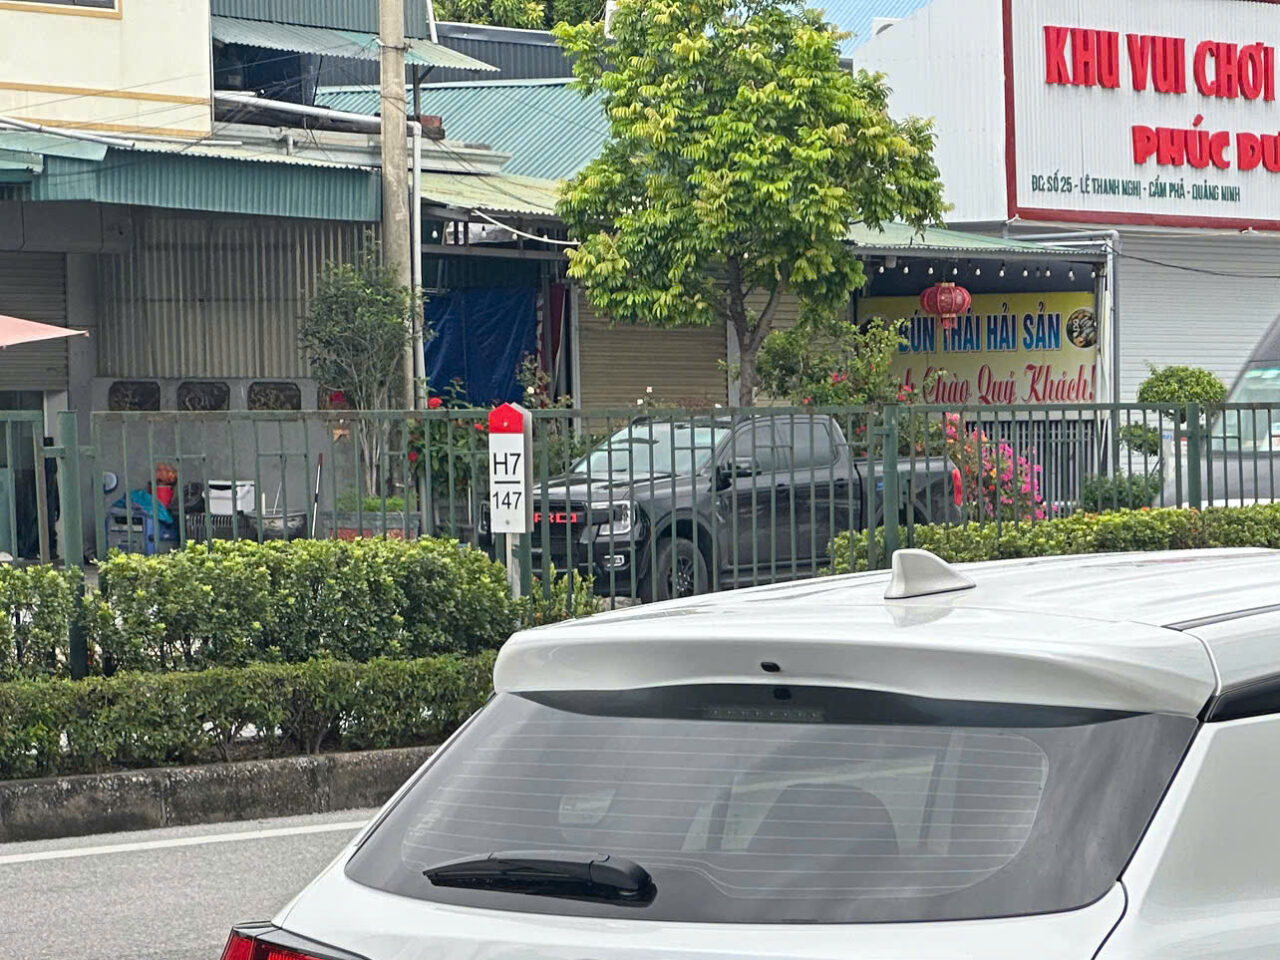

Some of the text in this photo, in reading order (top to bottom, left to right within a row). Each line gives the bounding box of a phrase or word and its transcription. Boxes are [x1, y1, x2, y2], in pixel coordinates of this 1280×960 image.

[1044, 25, 1120, 89] KHU
[1126, 33, 1187, 94] VUI
[1193, 39, 1275, 101] CHƠI
[1131, 113, 1230, 170] PHÚC
[1047, 169, 1059, 193] SỐ
[1060, 176, 1072, 193] 25
[1080, 174, 1090, 194] LÊ
[1092, 178, 1120, 195] THANH
[1121, 179, 1141, 199] NGHỊ
[1169, 178, 1185, 199] PHẢ
[1192, 180, 1219, 201] QUẢNG
[1221, 185, 1240, 202] NINH
[986, 302, 1017, 351] HẢI
[1023, 302, 1061, 350] SẢN
[493, 452, 521, 475] H7
[492, 491, 522, 510] 147
